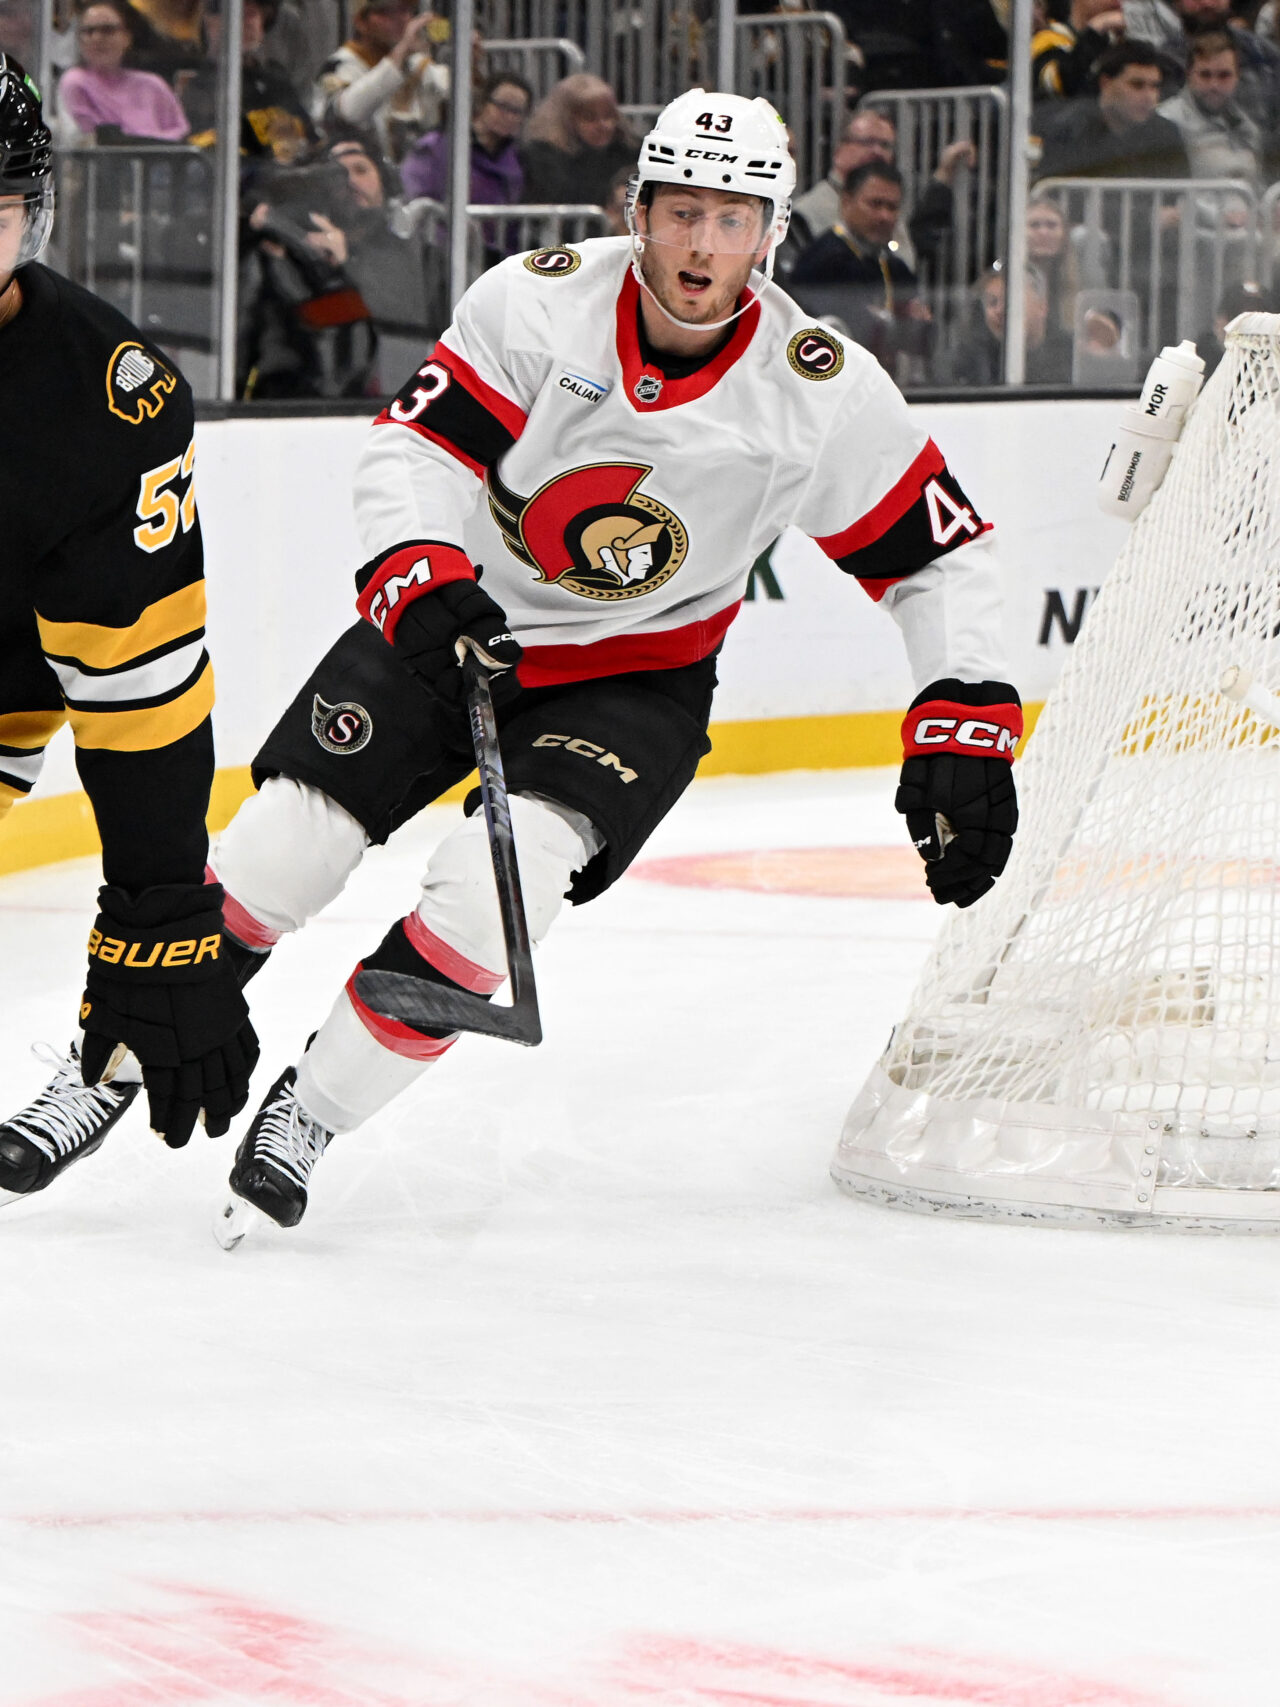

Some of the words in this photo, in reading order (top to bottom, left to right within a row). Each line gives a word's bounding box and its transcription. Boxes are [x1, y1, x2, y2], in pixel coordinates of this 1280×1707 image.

[695, 112, 733, 134] 43
[684, 149, 739, 164] CCM
[559, 377, 603, 403] CALIAN
[1037, 586, 1101, 646] N
[914, 718, 1020, 753] CCM
[532, 734, 639, 784] CCM
[87, 927, 221, 968] BAUER
